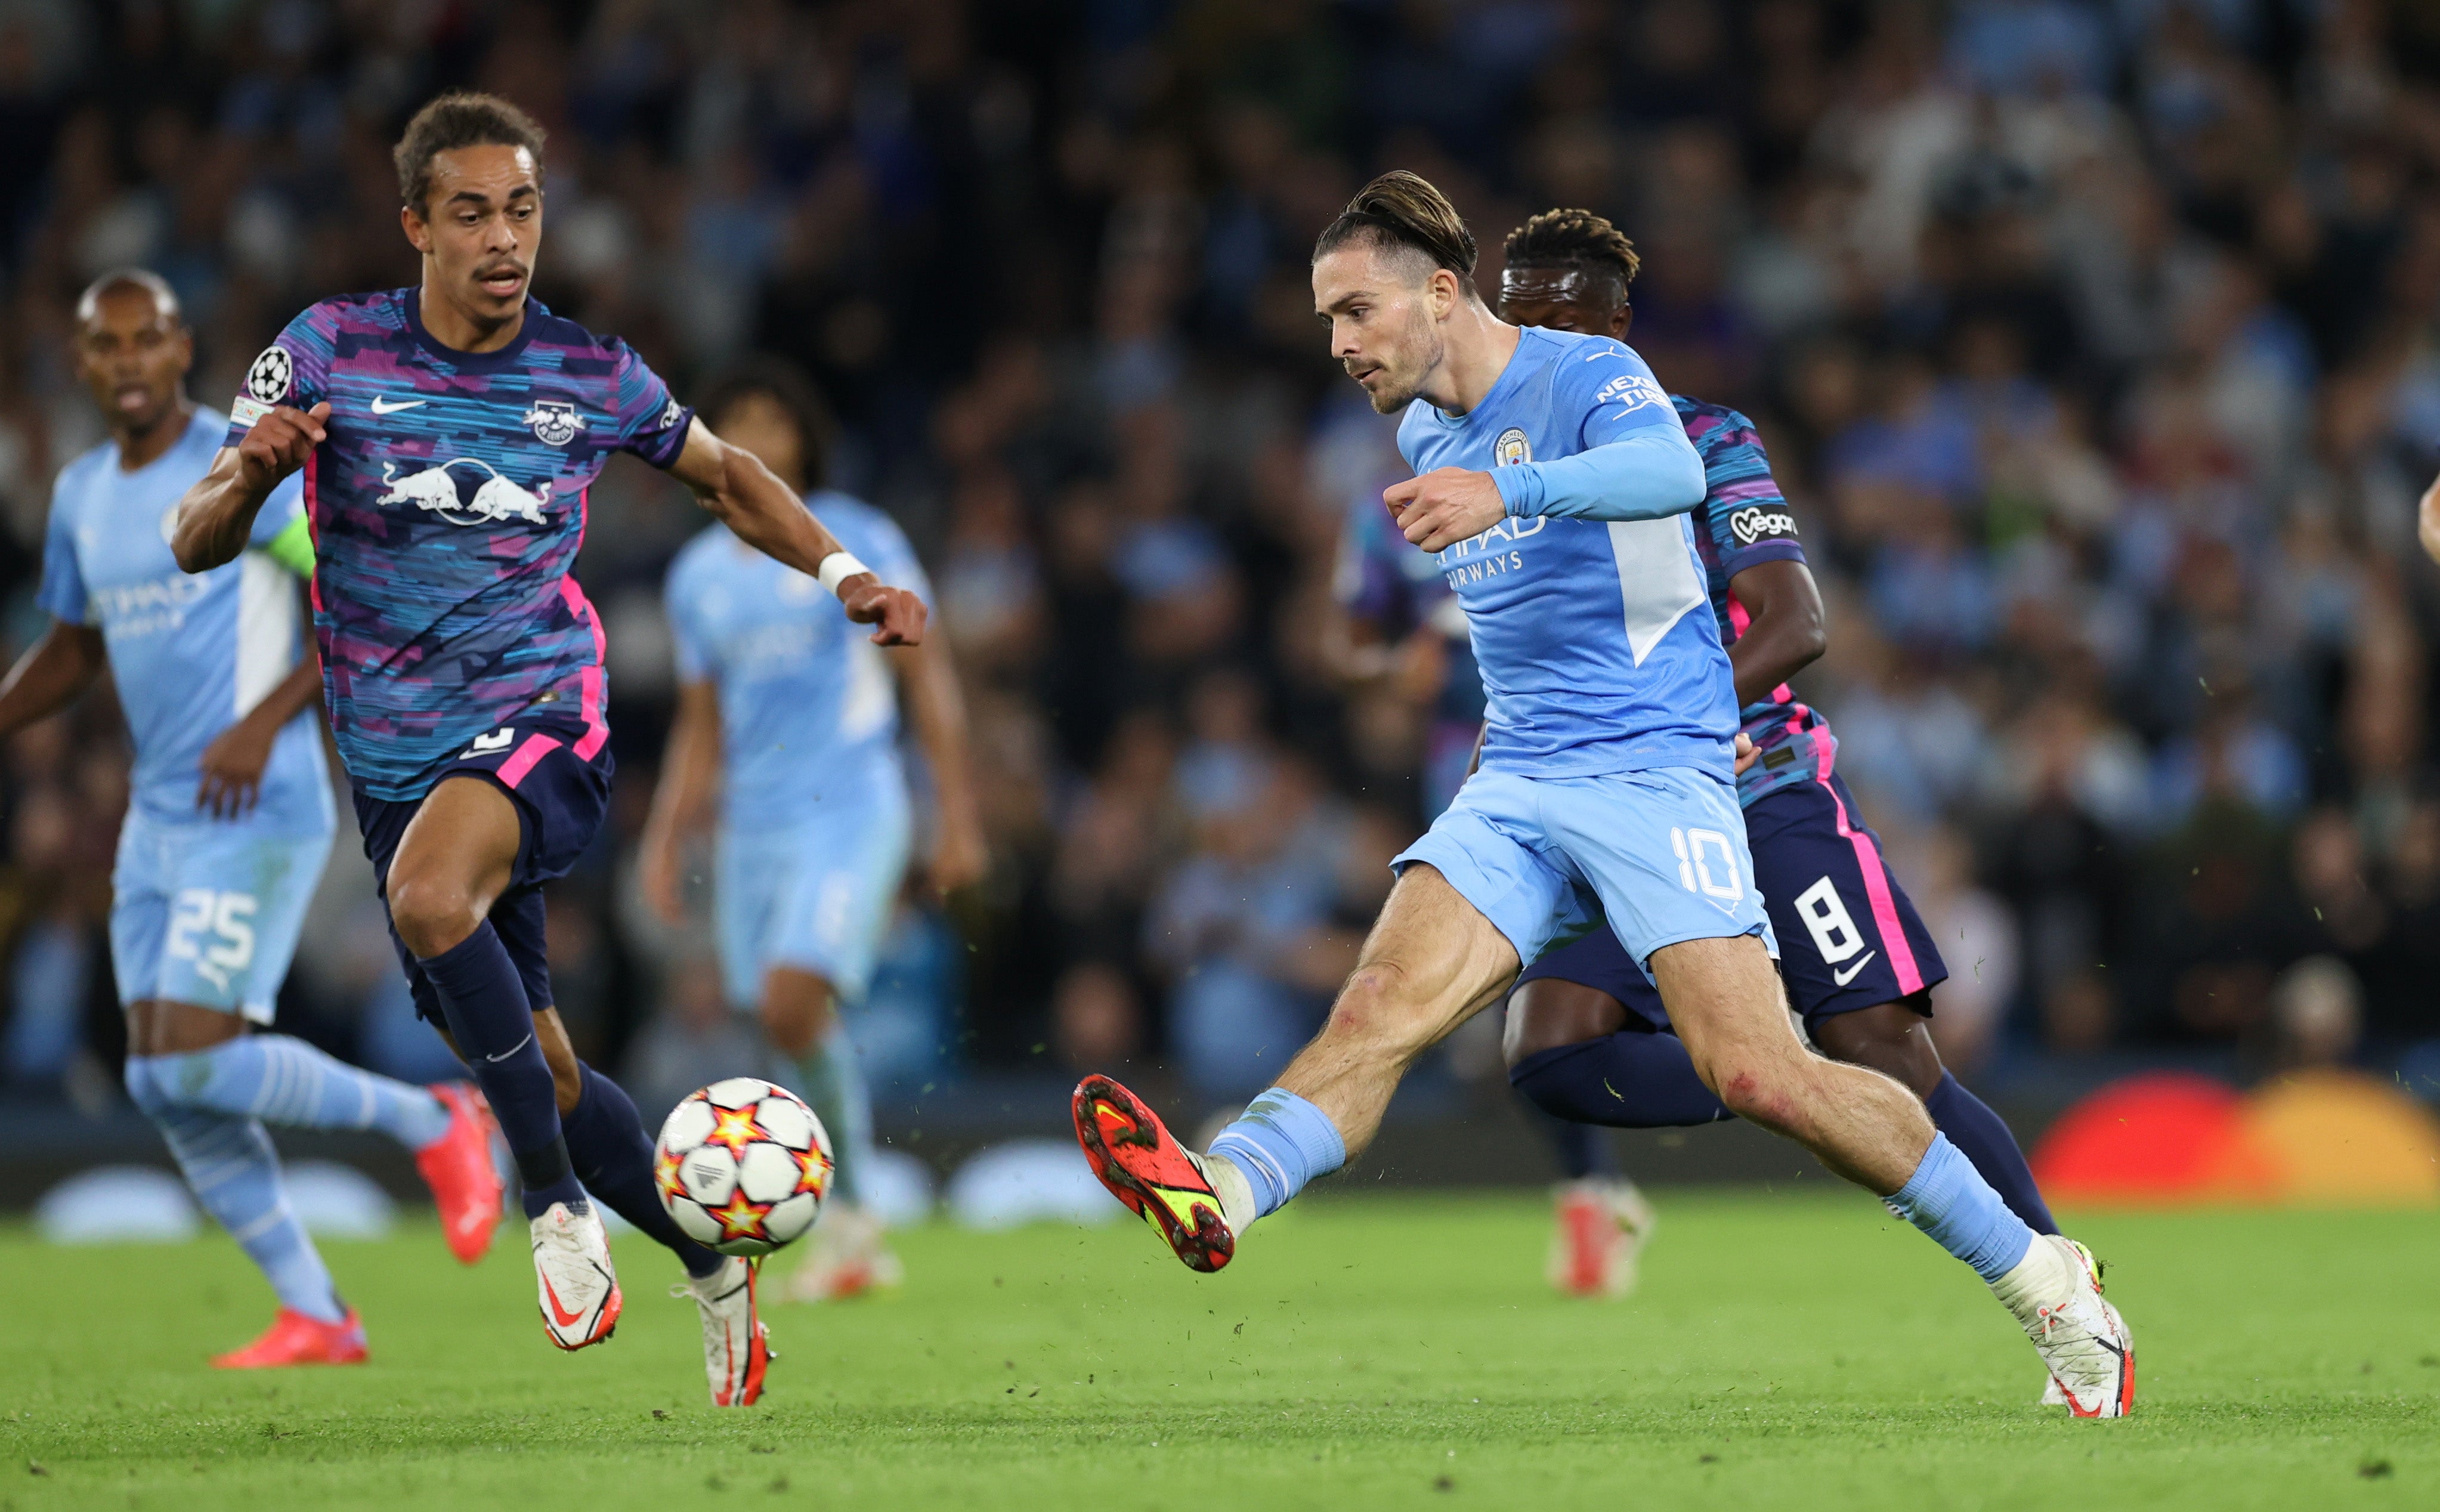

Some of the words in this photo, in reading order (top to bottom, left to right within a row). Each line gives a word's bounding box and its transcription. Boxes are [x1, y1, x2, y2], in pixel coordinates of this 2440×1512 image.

[1498, 431, 1527, 452] MANCHESTER
[1446, 551, 1522, 590] AIRWAYS
[1671, 827, 1743, 900] 10
[168, 889, 258, 967] 25
[1793, 875, 1865, 964] 8
